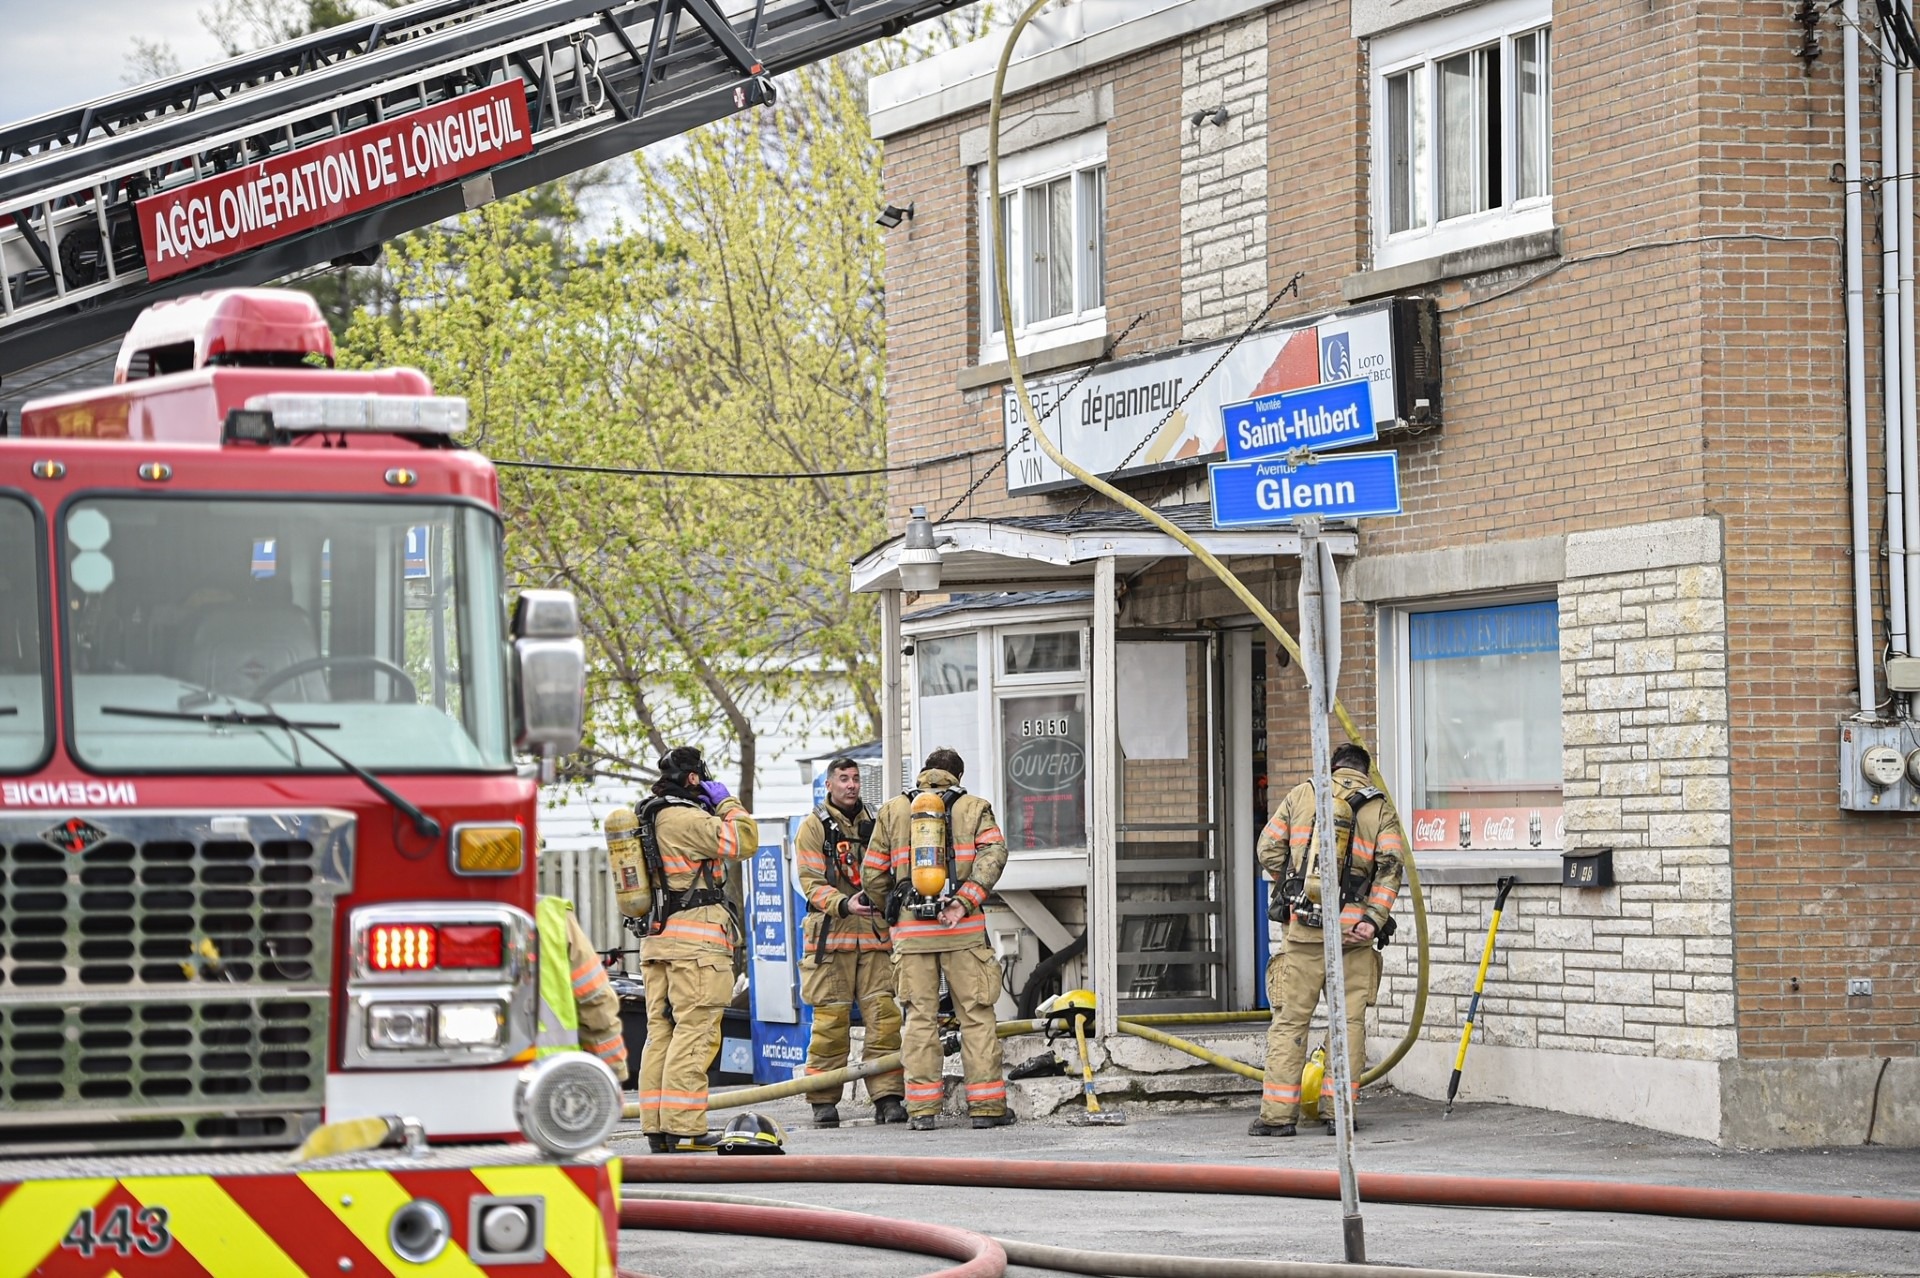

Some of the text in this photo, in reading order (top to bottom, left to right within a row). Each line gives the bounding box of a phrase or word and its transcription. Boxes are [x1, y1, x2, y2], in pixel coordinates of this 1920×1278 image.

[155, 97, 523, 262] AGGLOMÉRATION DE LONGUEUIL
[1358, 354, 1384, 369] LOTO
[1081, 377, 1183, 432] dépanneur
[1255, 398, 1282, 412] Montée
[1238, 402, 1361, 450] Saint-Hubert
[1020, 456, 1042, 484] VIN
[1256, 463, 1298, 476] Avenue
[1256, 478, 1356, 511] Glenn
[1023, 720, 1067, 736] 5350
[1012, 753, 1080, 777] OUVERT
[758, 858, 776, 870] ARCTIC
[758, 870, 777, 882] GLACIER
[762, 1044, 804, 1061] ARCTIC GLACIER
[62, 1206, 171, 1257] 443
